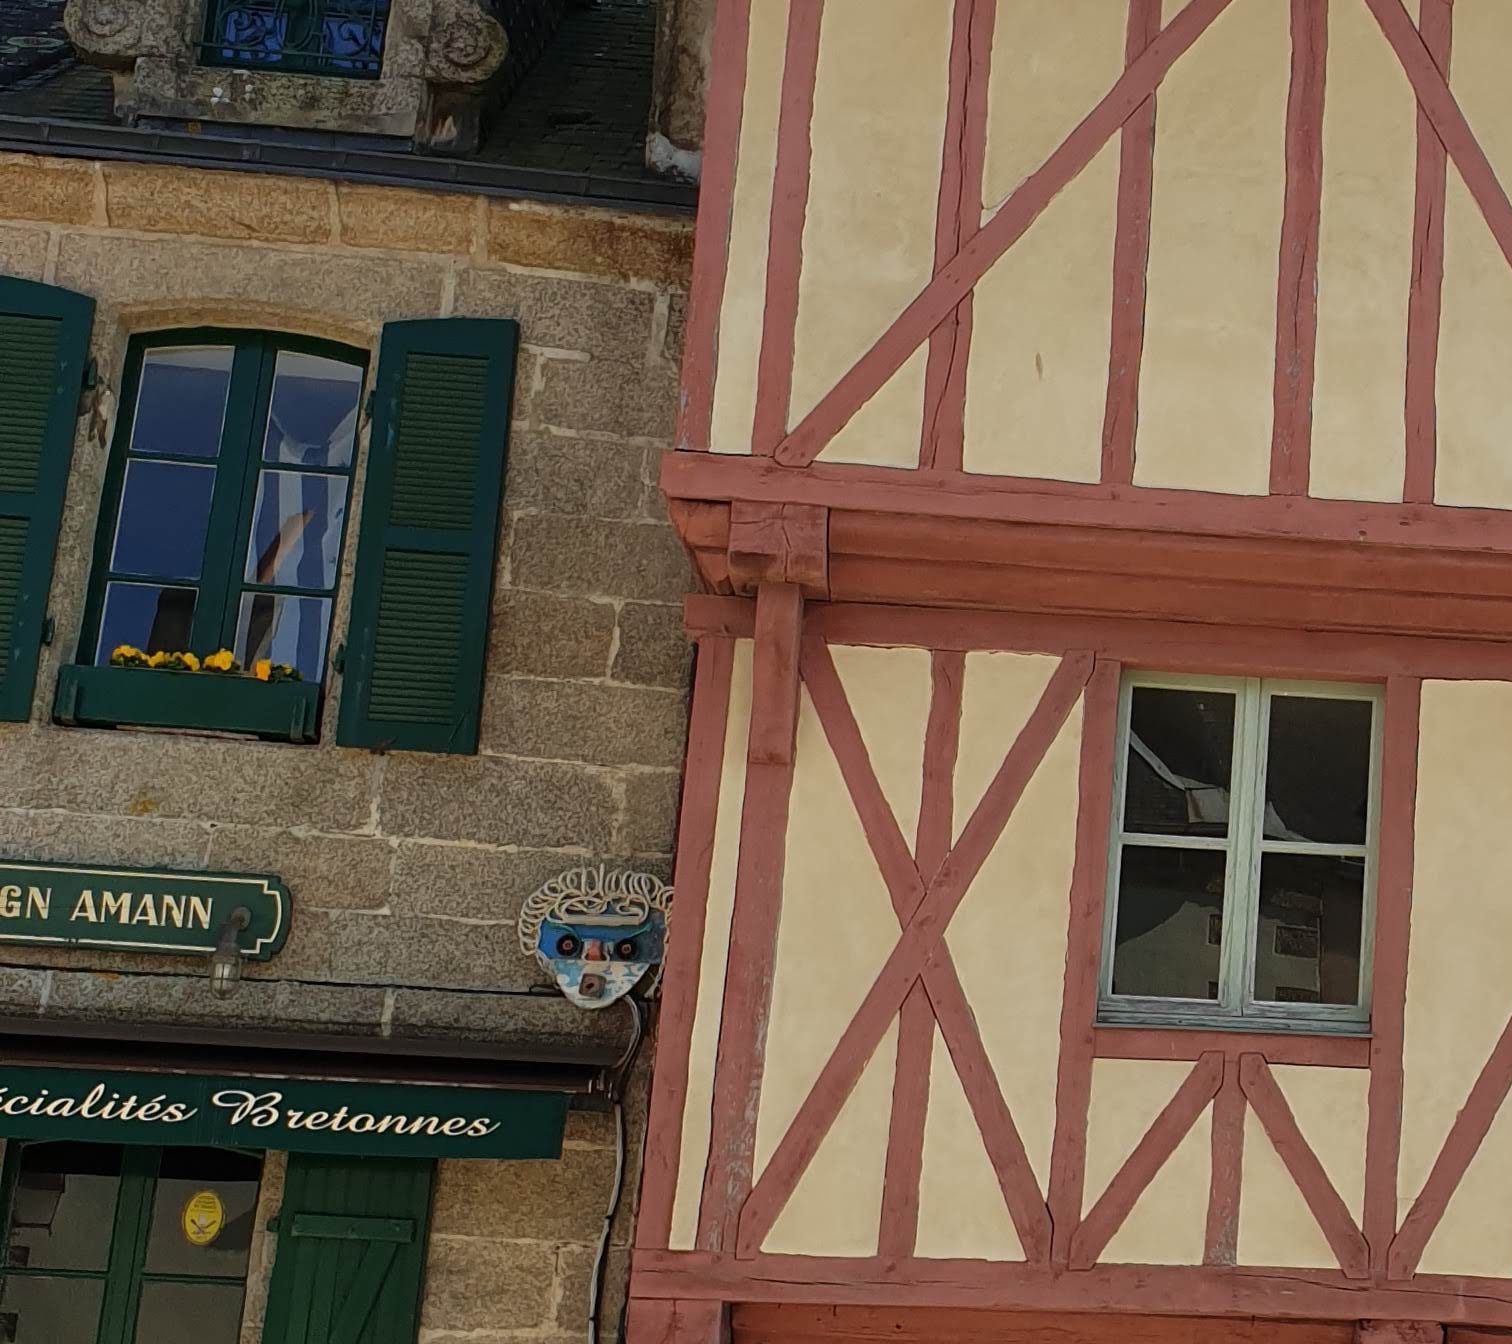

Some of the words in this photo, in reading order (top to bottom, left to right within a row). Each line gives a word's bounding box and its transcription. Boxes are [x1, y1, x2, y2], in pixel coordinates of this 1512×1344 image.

[69, 889, 214, 930] AMANN
[0, 1083, 198, 1122] cialités
[212, 1090, 500, 1137] Bretonnes
